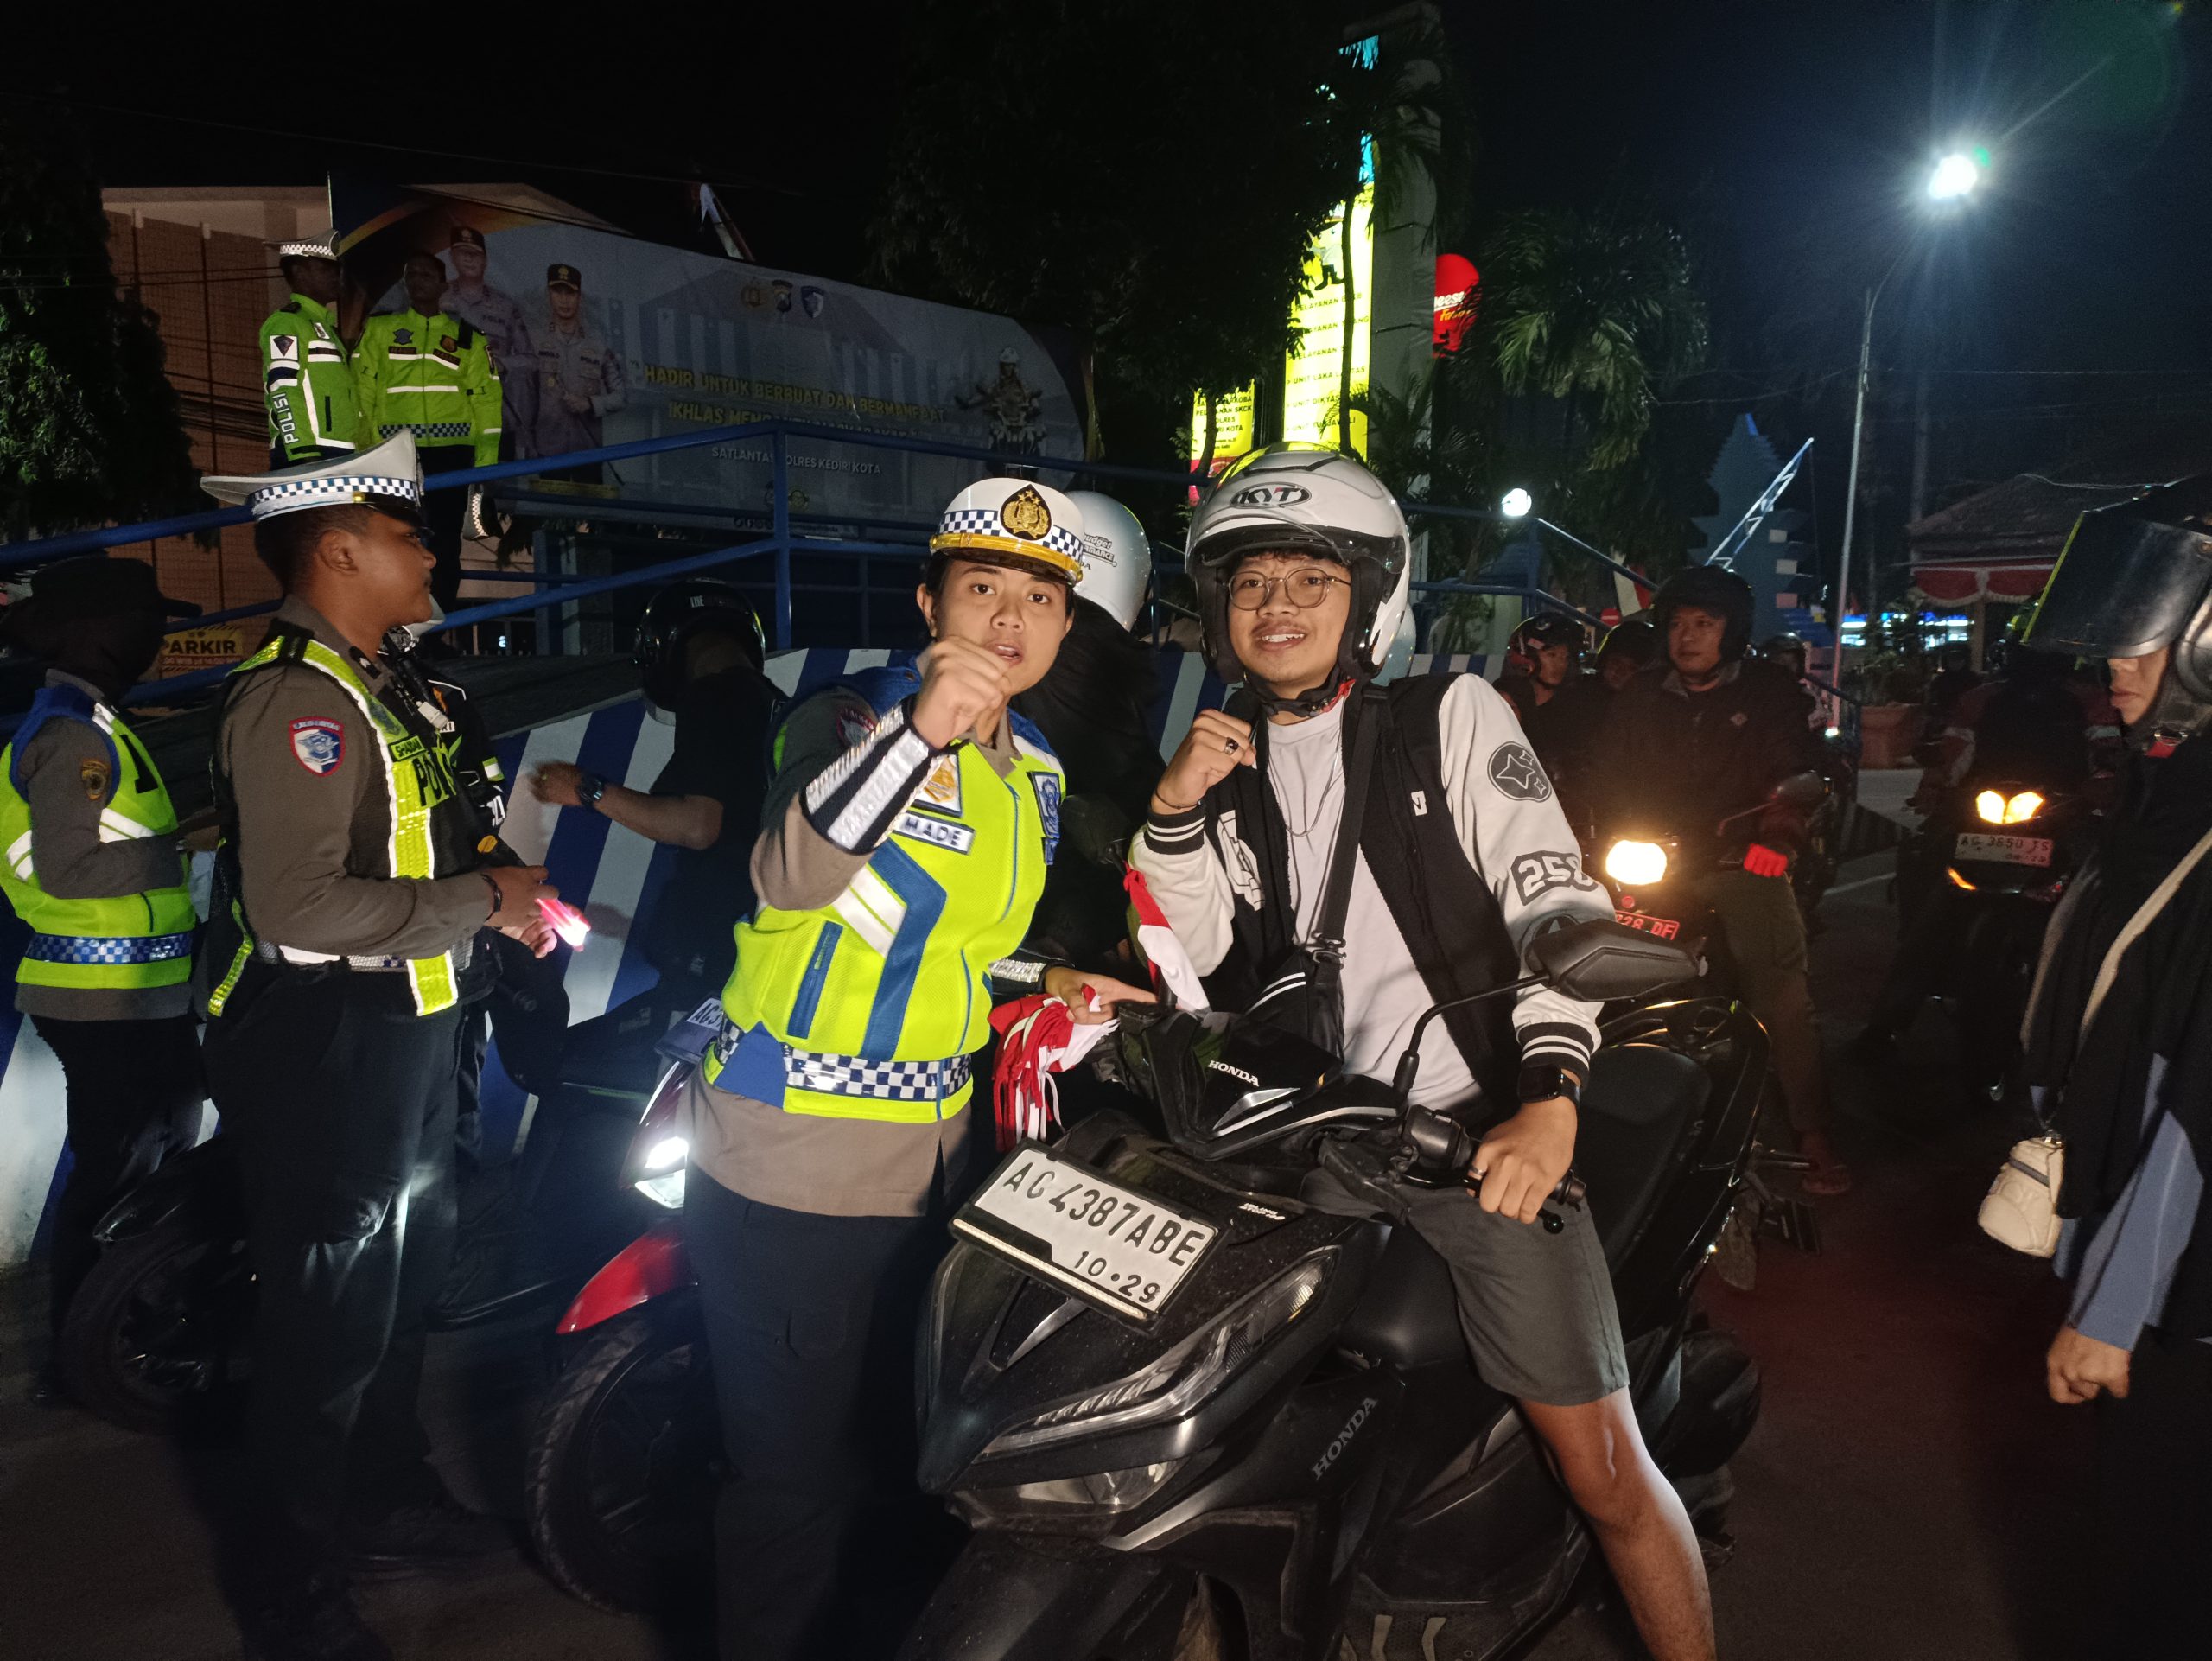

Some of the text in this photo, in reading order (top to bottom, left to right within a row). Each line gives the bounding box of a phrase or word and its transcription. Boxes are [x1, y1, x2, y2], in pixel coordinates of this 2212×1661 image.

[645, 365, 693, 387] HADIR
[702, 373, 751, 396] UNTUK
[752, 381, 821, 406] BERBUAT
[827, 392, 854, 410] DAN
[271, 392, 299, 444] POLISI
[669, 401, 724, 423] IKHLAS
[785, 455, 817, 468] OLRES
[818, 459, 852, 472] KEDIRI
[852, 461, 882, 474] KOTA
[1238, 486, 1300, 505] KYT
[1084, 533, 1113, 549] udget
[166, 640, 236, 654] ARKIR
[1208, 1060, 1260, 1087] HONDA
[1313, 1397, 1378, 1480] HONDA
